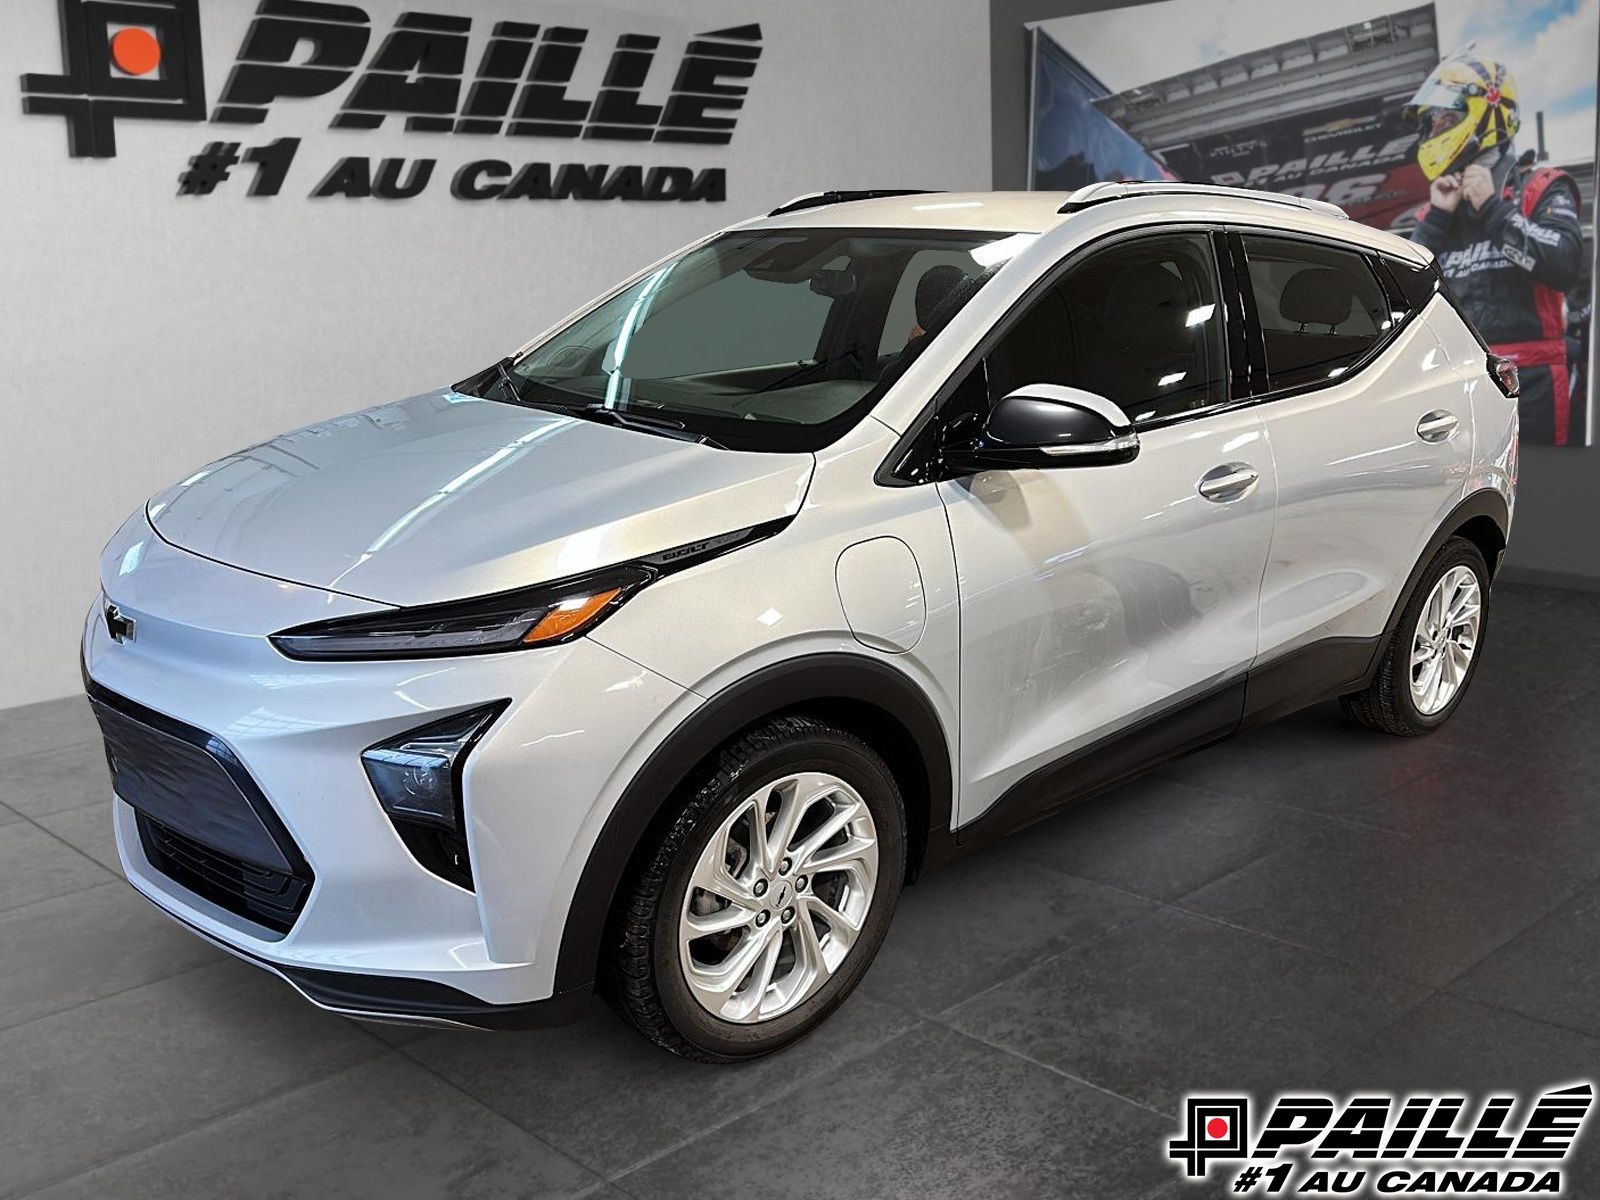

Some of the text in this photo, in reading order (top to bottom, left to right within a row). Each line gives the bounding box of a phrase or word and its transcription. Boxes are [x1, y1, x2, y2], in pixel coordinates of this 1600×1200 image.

[208, 0, 763, 145] PAILLÉ
[176, 137, 728, 202] #1 AU CANADA
